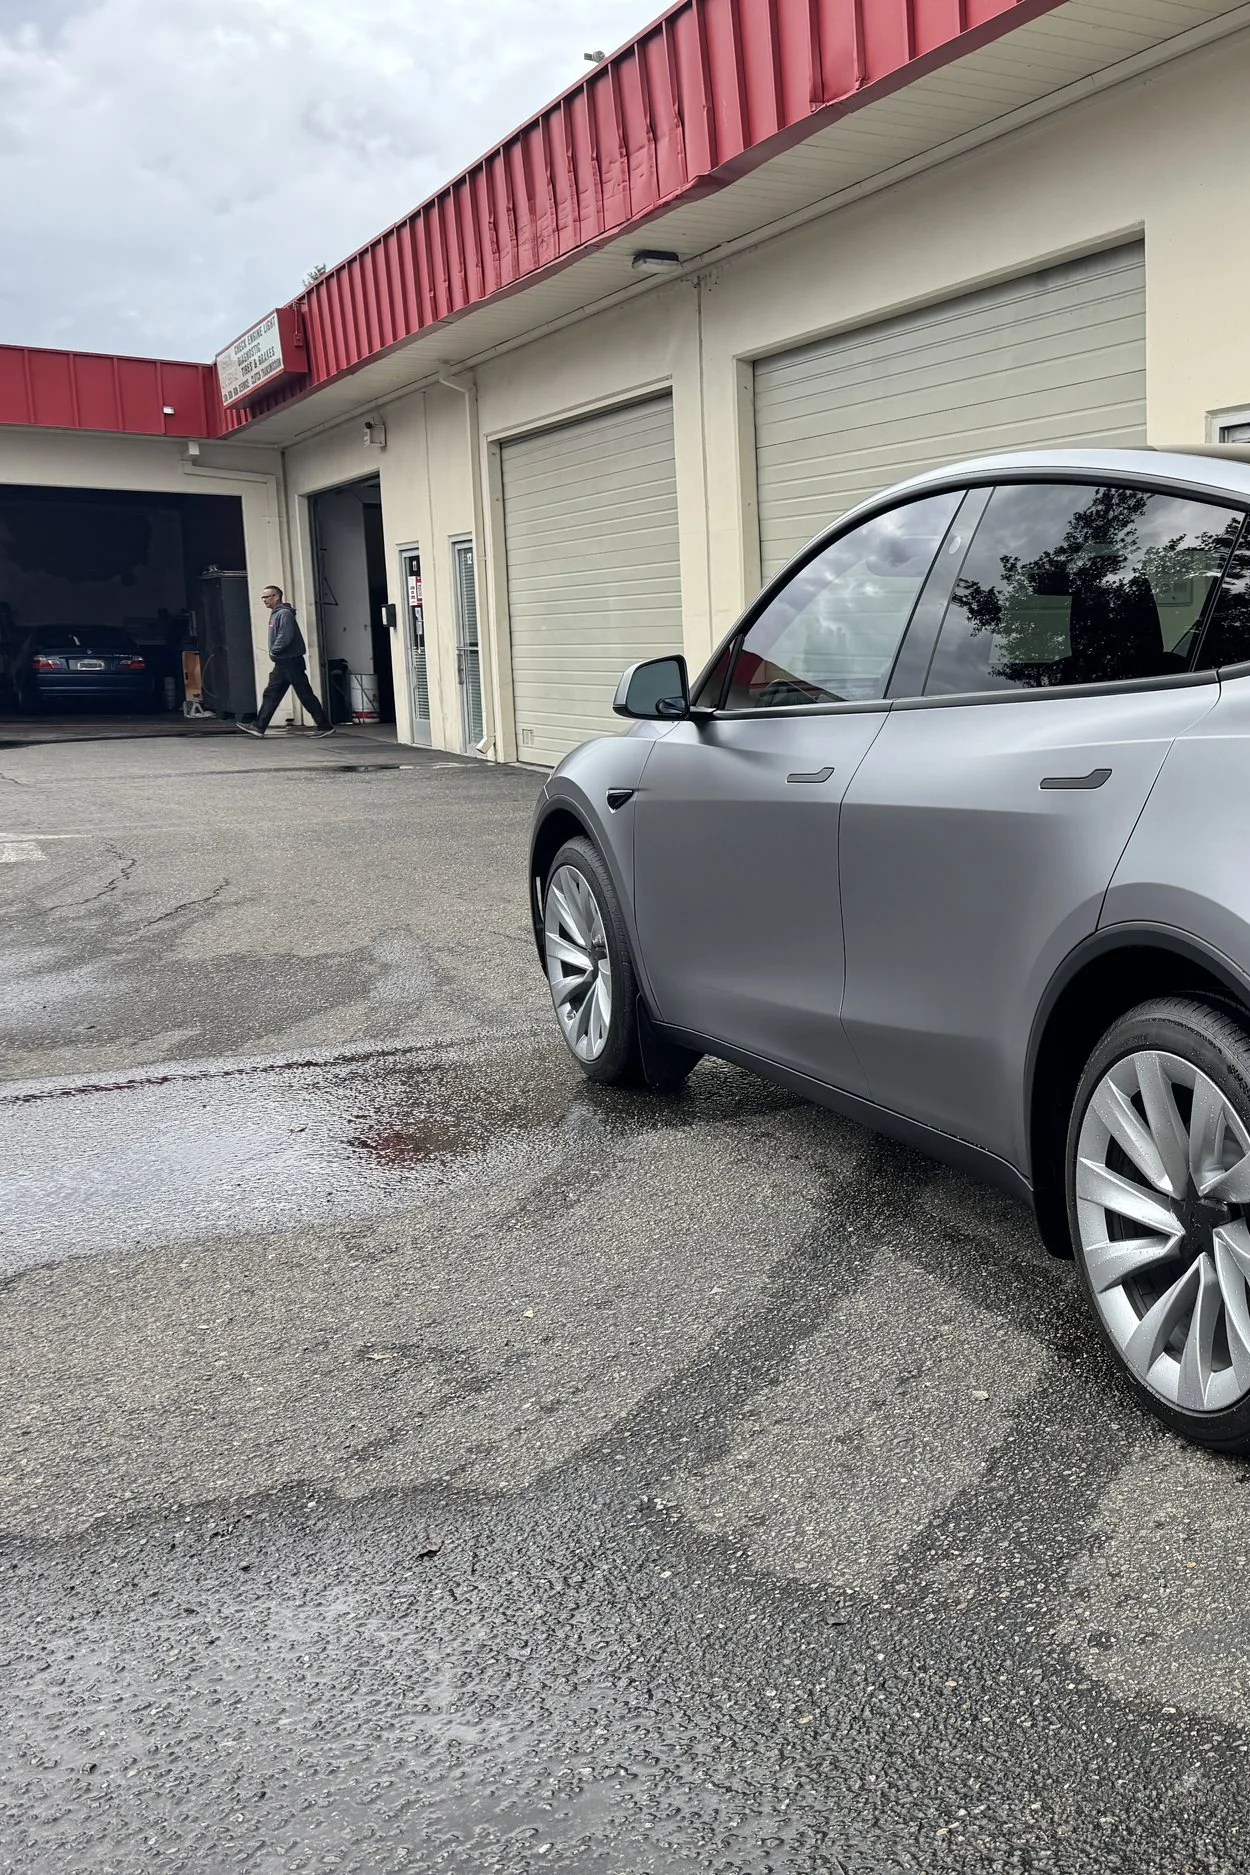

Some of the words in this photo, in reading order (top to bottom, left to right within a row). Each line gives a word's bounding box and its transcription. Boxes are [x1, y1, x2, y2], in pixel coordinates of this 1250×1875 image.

[248, 327, 263, 345] ENGINE
[263, 316, 276, 333] LIGHT
[241, 360, 253, 377] TIRES
[258, 346, 275, 365] BRAKES
